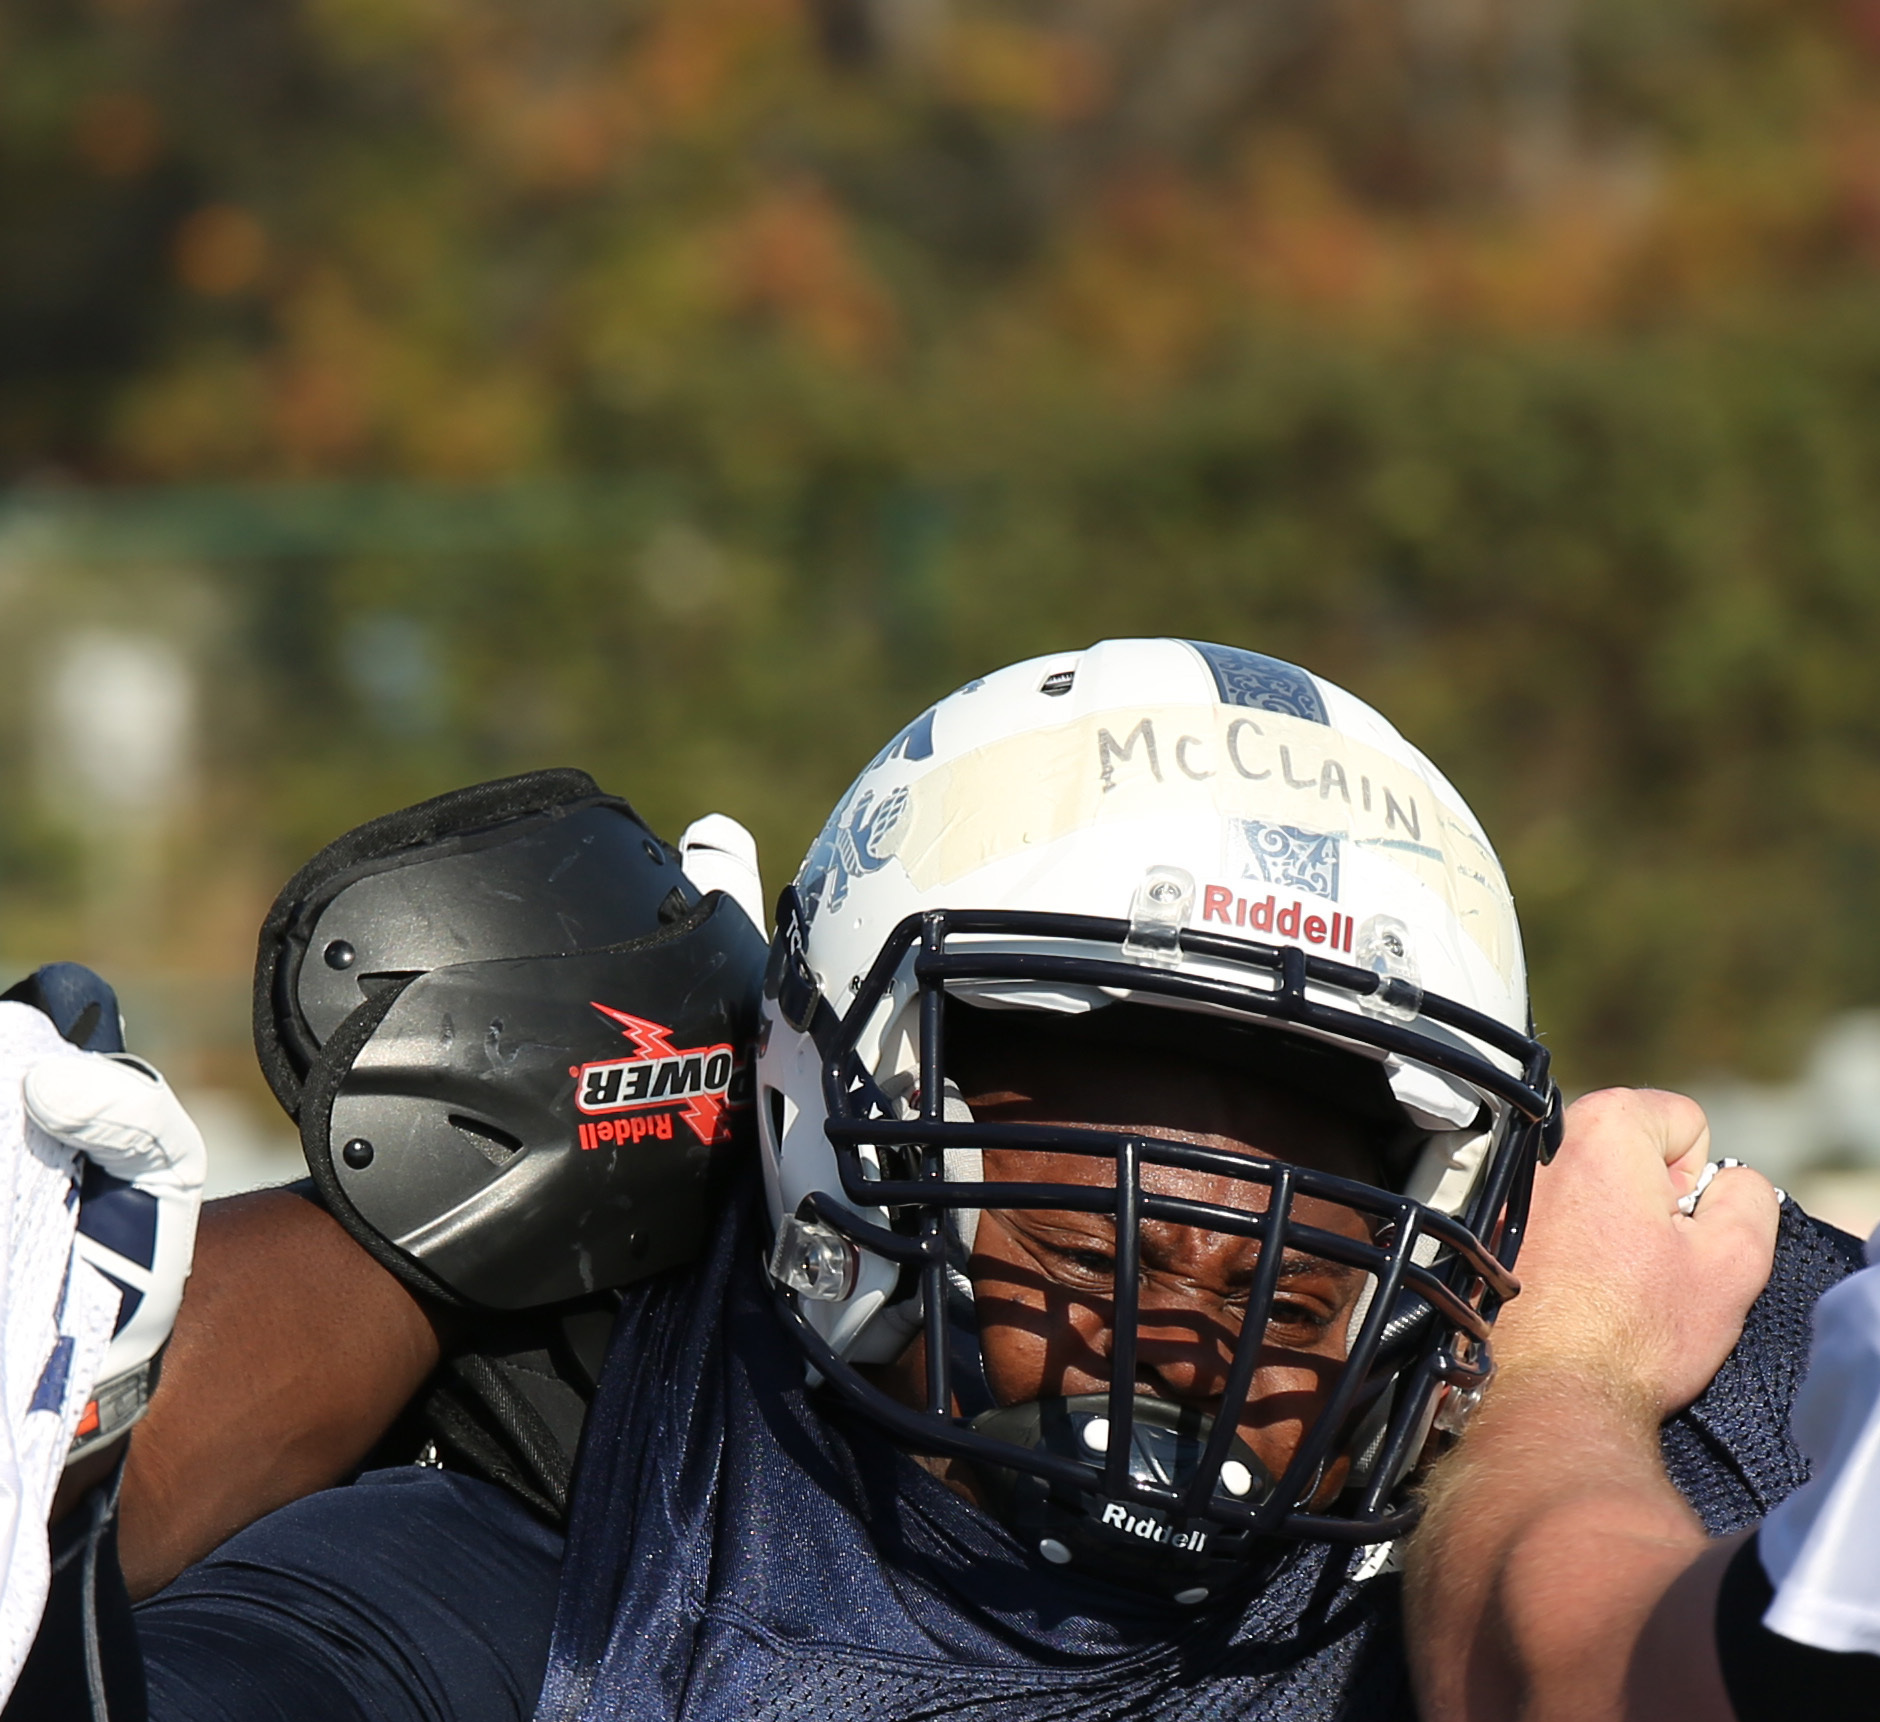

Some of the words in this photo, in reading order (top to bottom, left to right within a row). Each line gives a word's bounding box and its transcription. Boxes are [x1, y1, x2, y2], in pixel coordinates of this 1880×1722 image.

[1202, 884, 1355, 953] Riddell
[578, 1113, 673, 1150] Riddell
[1102, 1503, 1208, 1552] Riddell
